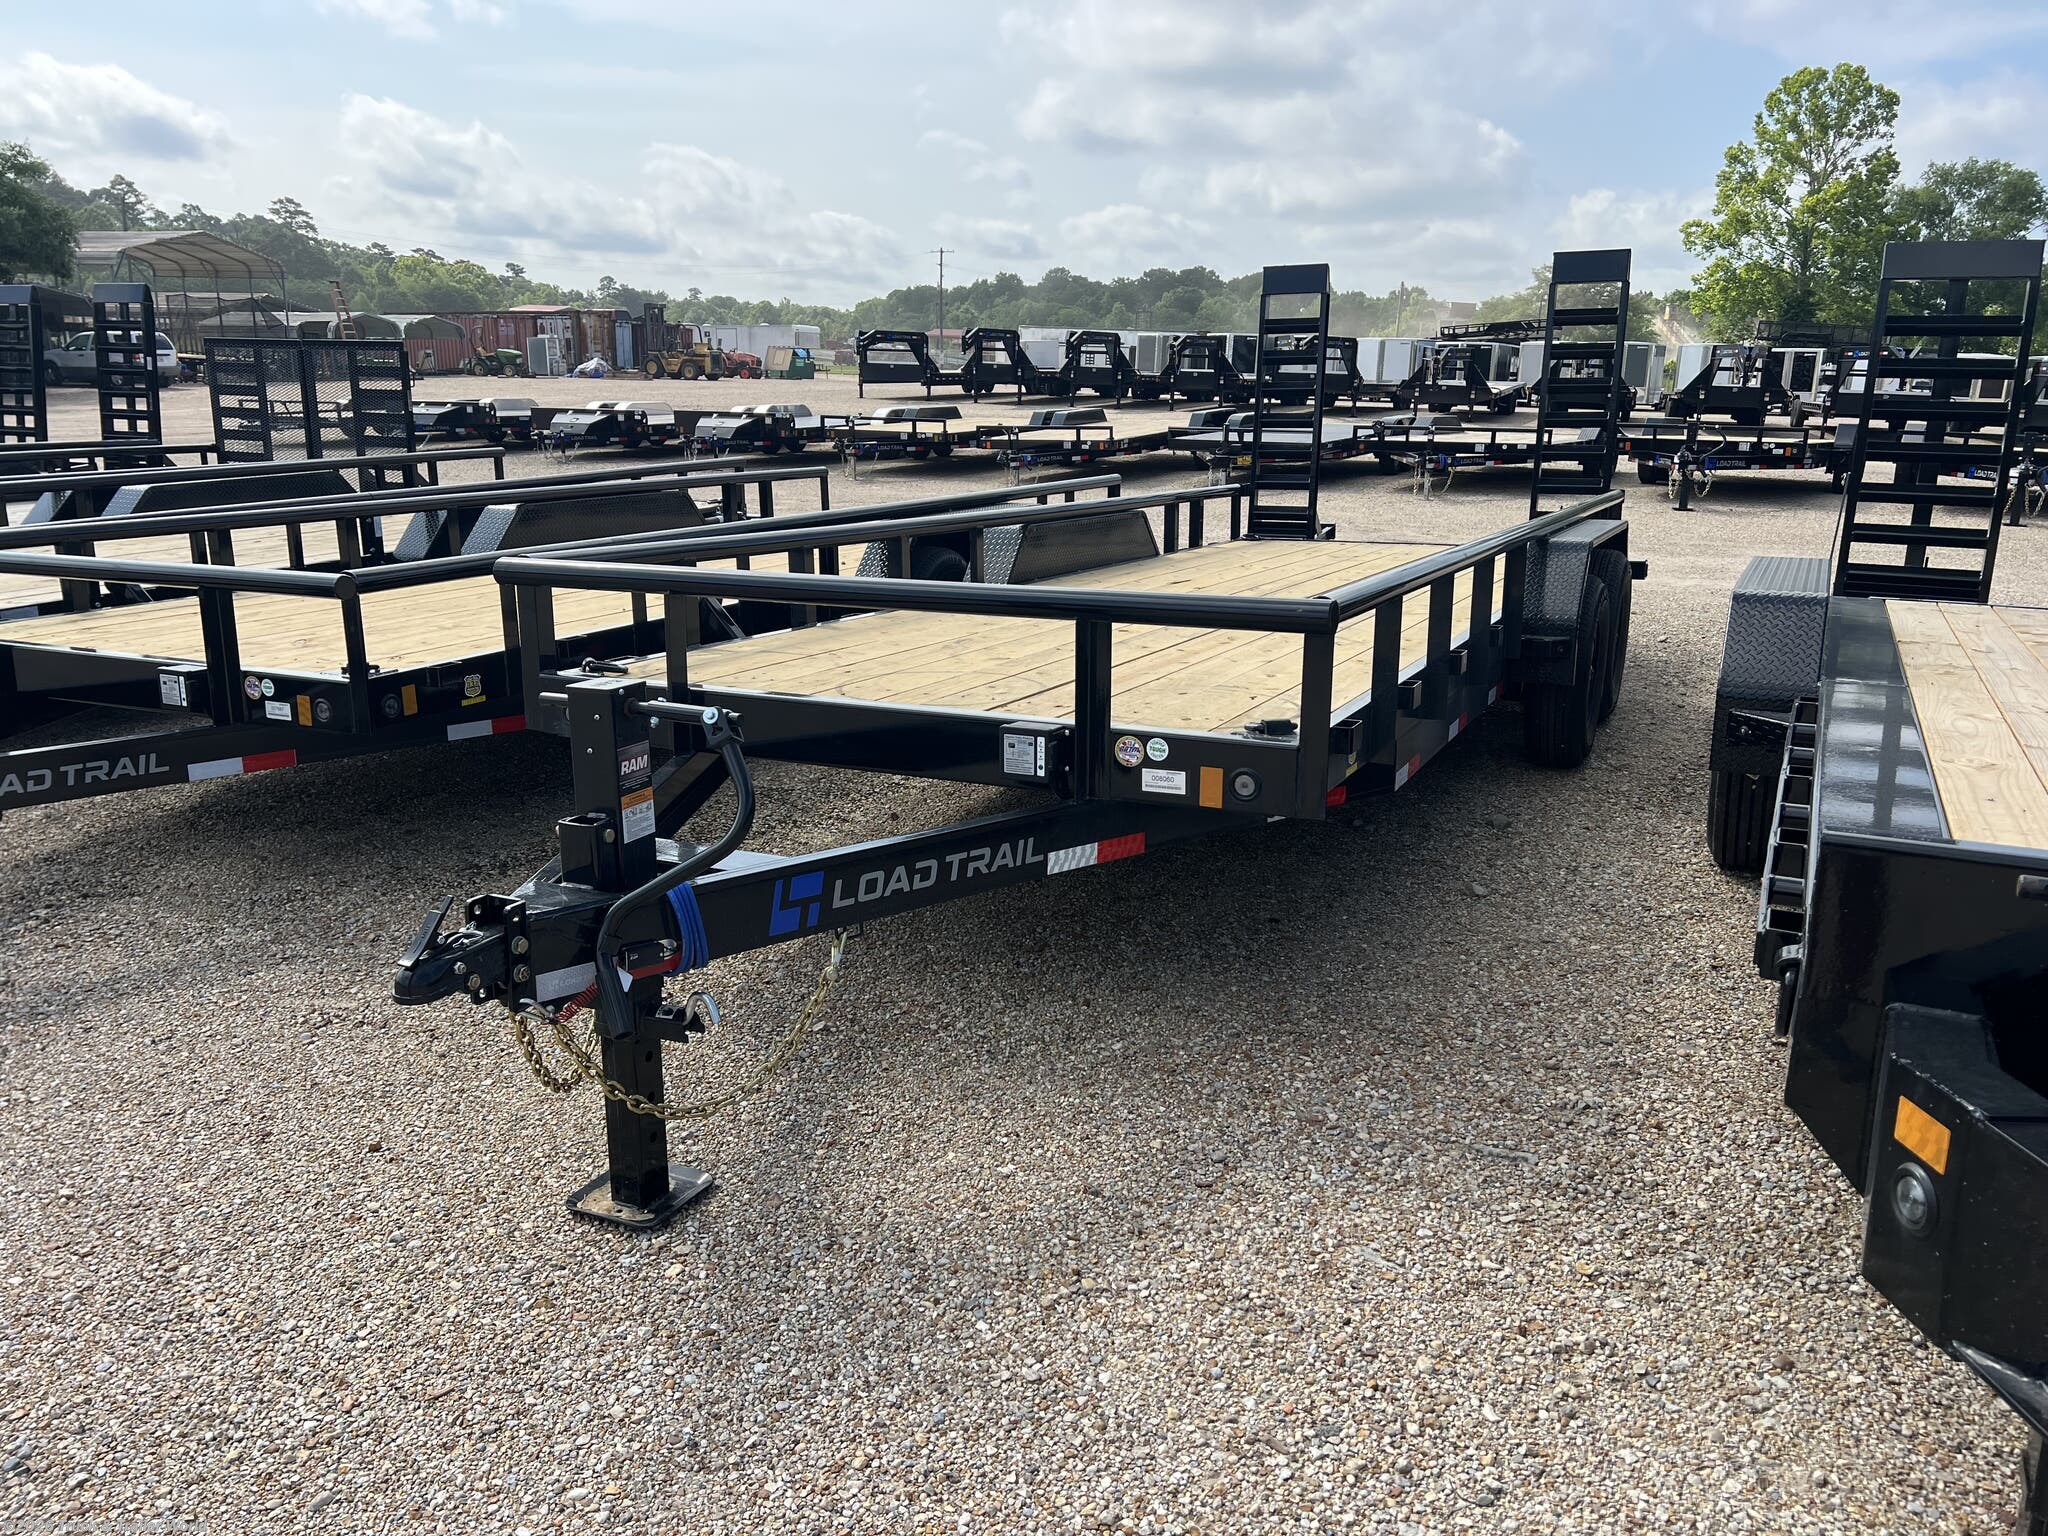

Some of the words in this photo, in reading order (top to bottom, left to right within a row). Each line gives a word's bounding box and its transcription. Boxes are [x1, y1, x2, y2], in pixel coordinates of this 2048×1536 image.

[0, 768, 52, 797] AD
[59, 752, 170, 786] TRAIL
[620, 754, 648, 776] RAM
[832, 859, 938, 909] LOAD
[945, 837, 1044, 881] TRAIL
